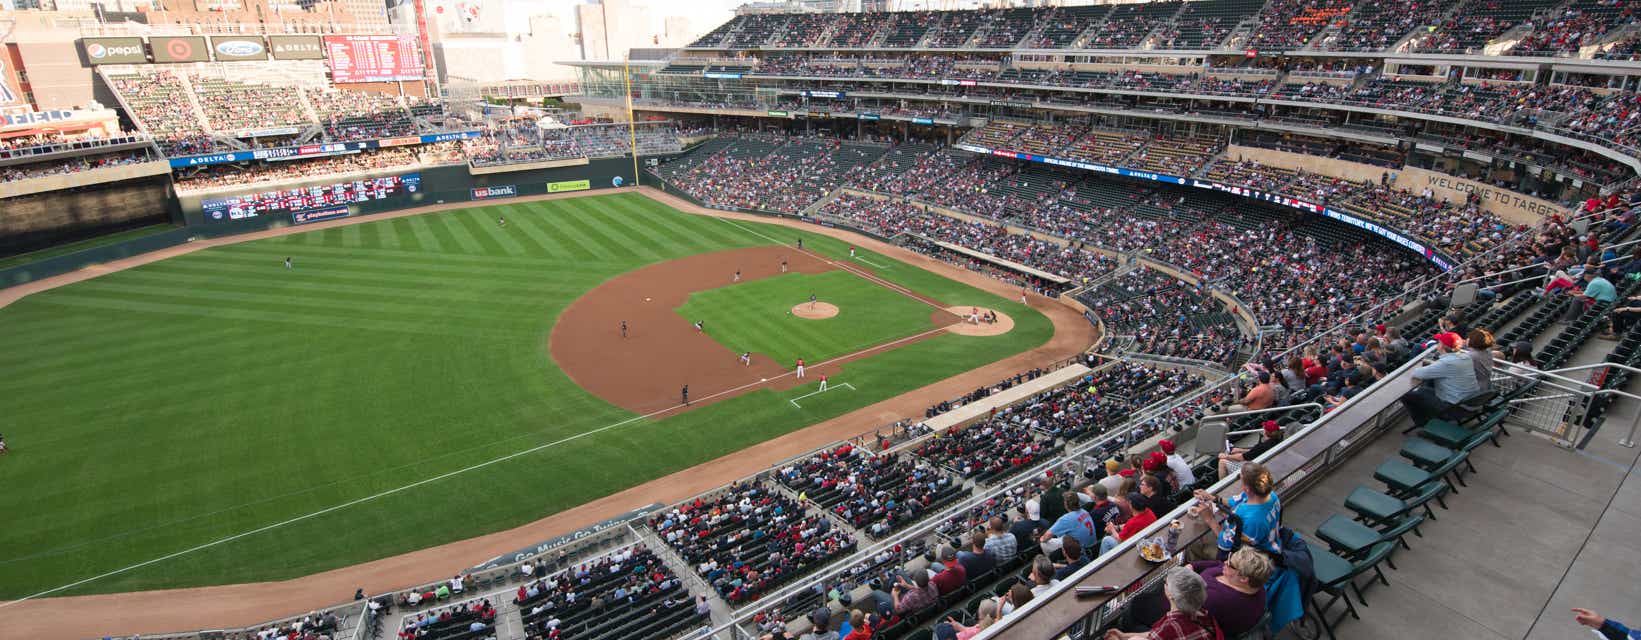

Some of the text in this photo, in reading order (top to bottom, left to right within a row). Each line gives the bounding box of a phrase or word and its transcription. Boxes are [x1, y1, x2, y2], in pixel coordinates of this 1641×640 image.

[107, 45, 141, 57] pepsi
[286, 44, 320, 52] DELTA
[198, 155, 225, 164] DELTA
[1428, 175, 1490, 199] WELCOME
[1494, 191, 1510, 205] TO
